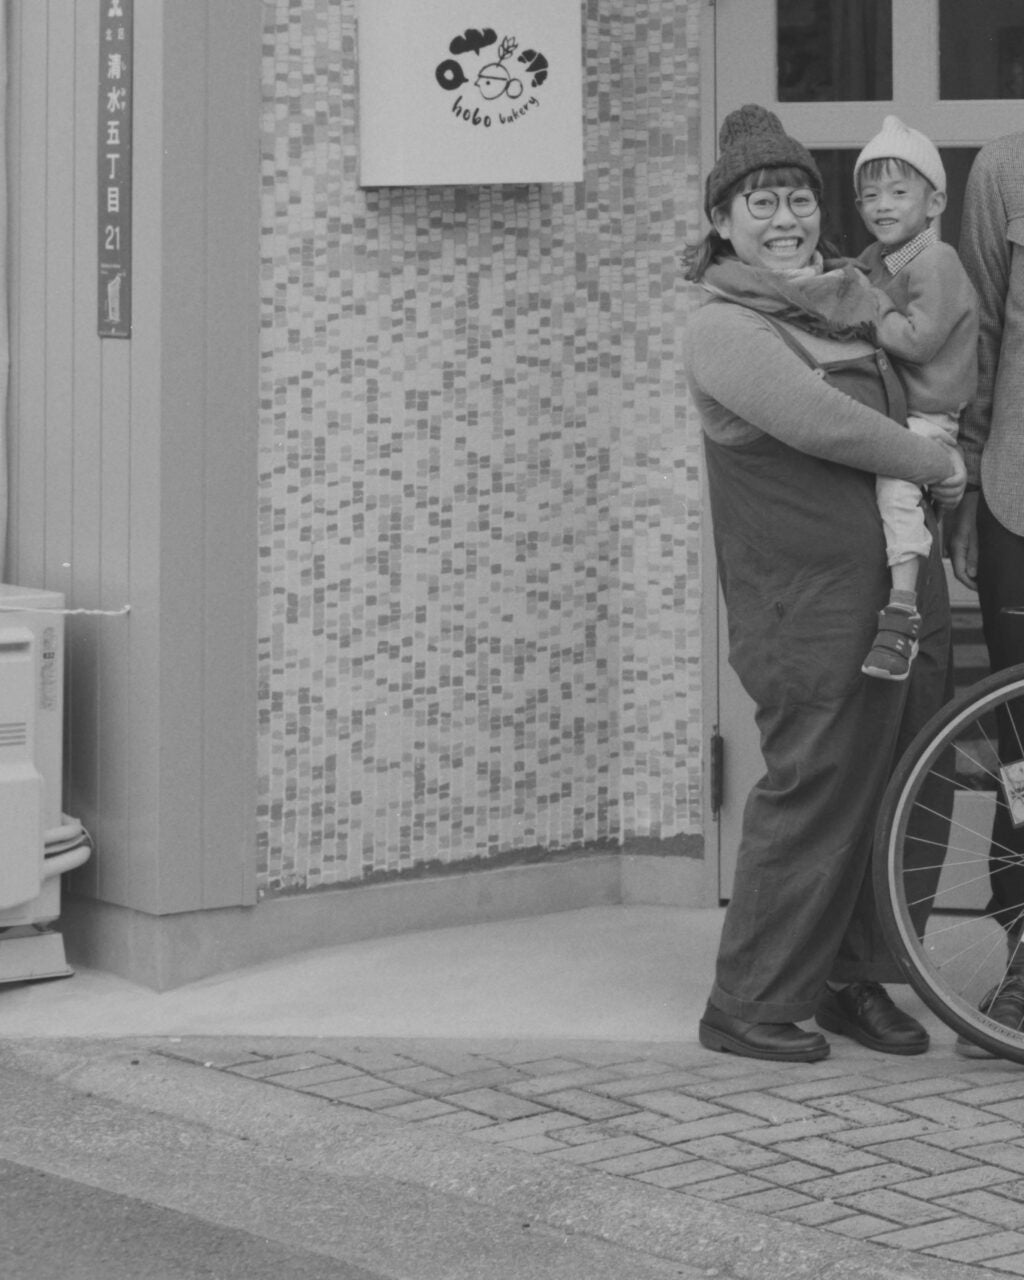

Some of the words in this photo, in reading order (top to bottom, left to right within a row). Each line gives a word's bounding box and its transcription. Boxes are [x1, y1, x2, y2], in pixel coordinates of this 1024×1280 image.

[452, 95, 492, 128] hobo
[499, 96, 540, 124] bakery
[106, 53, 122, 212] 清水五丁目
[105, 225, 121, 250] 21
